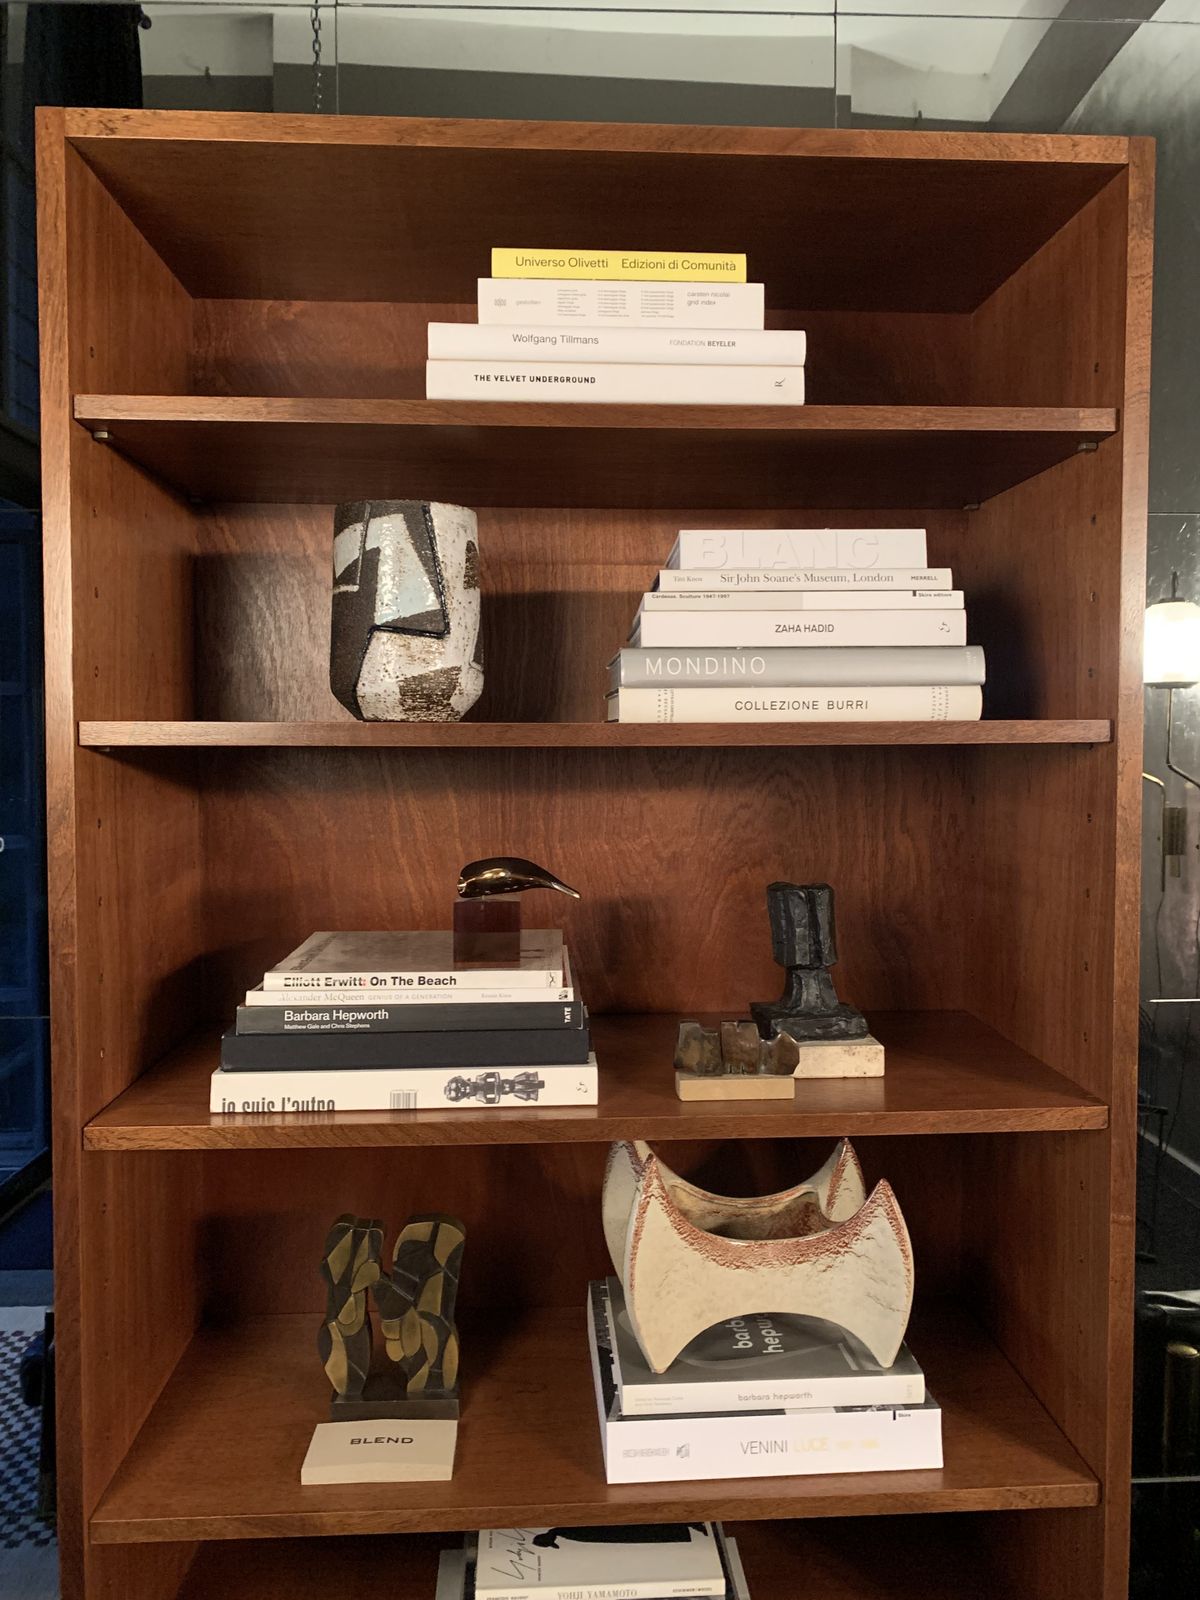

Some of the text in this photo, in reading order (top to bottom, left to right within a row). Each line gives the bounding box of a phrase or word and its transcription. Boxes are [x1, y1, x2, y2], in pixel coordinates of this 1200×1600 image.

[515, 256, 736, 271] Universo Olivetti Edizioni di Comunità
[512, 334, 599, 345] Wolfgang Tillmans
[669, 339, 706, 347] FONDATION
[474, 374, 596, 384] THE VELVET UNDERGROUND
[693, 532, 879, 568] BLANC
[720, 573, 894, 585] Sir John Soane's Museum, London
[775, 624, 835, 633] ZAHA HADID
[645, 656, 766, 676] MONDINO
[735, 700, 869, 711] COLLEZIONE BURRI
[283, 977, 321, 987] Elliott
[370, 976, 387, 986] On
[391, 976, 414, 986] The
[418, 975, 457, 986] Beach
[325, 993, 365, 1003] McQueen
[284, 1009, 389, 1022] Barbara Hepworth
[564, 1007, 572, 1023] TATE
[737, 1391, 813, 1401] barbara hepworth
[350, 1437, 414, 1445] BLEND
[740, 1440, 788, 1454] VENINI
[586, 1589, 638, 1599] YAMAMOTO
